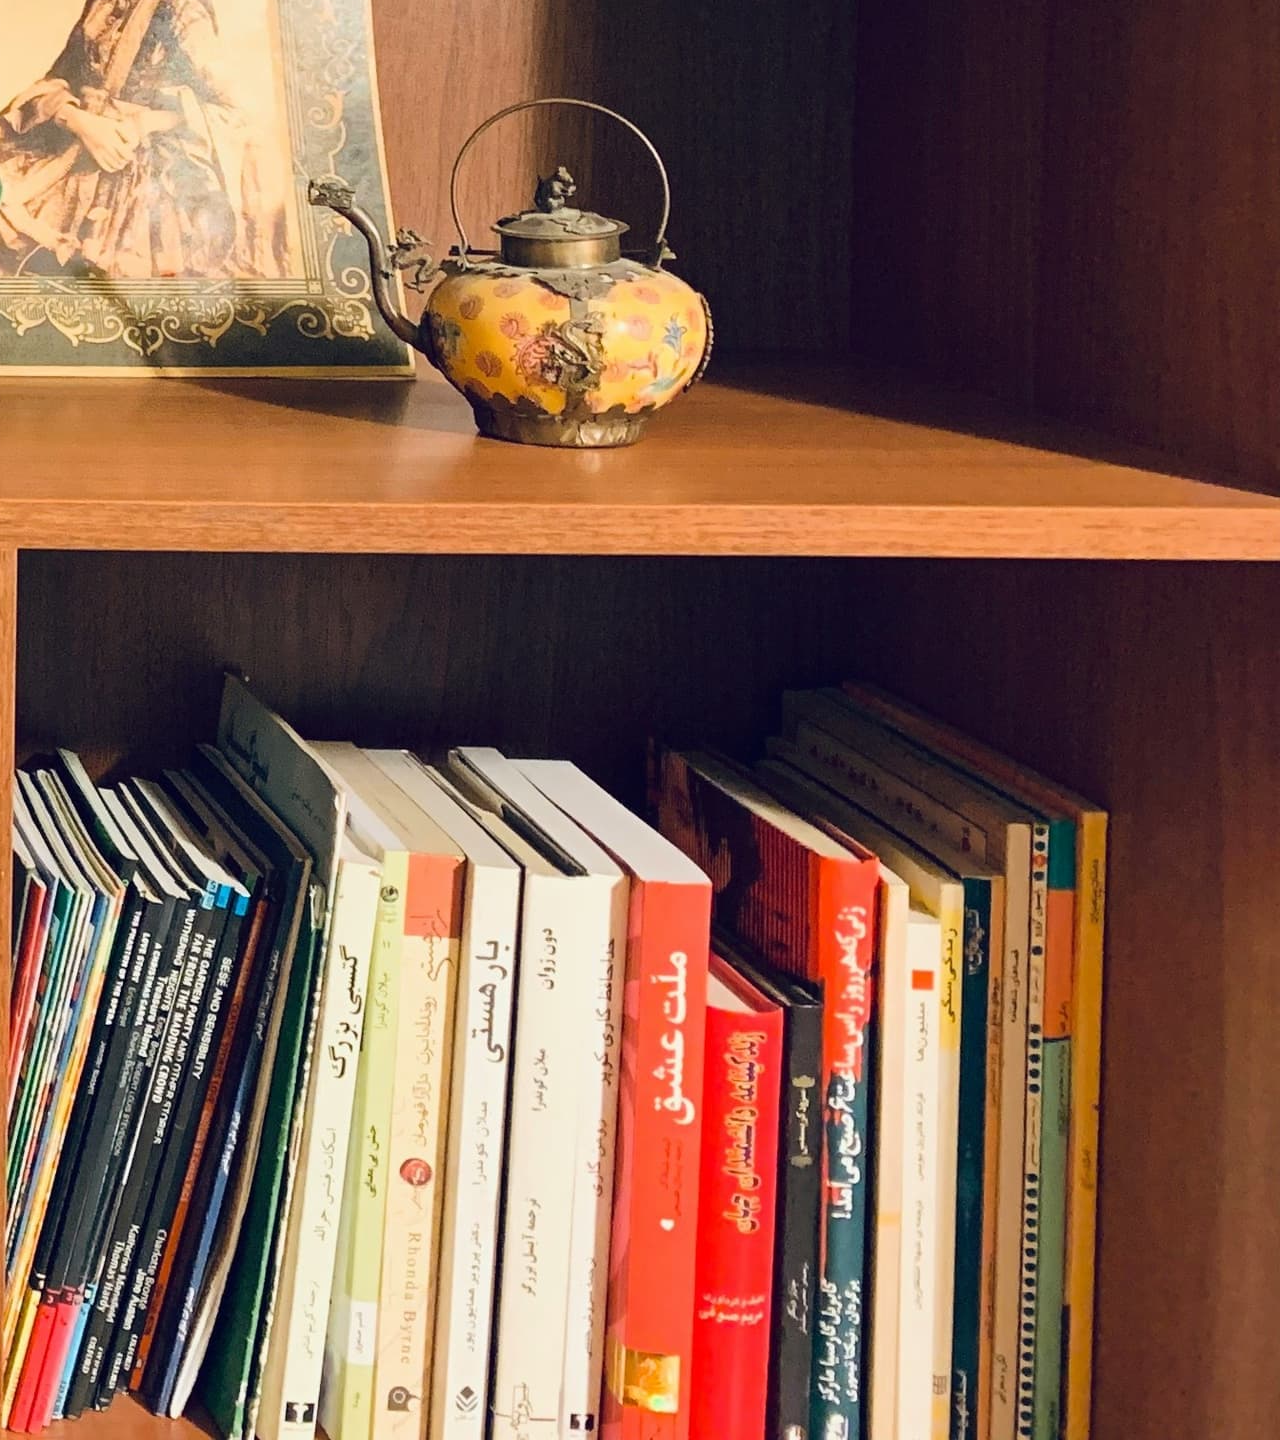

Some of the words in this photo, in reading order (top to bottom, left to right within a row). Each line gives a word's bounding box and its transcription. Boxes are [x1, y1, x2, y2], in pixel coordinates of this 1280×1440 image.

[173, 909, 197, 966] WUTHERING
[192, 932, 205, 954] FAR
[474, 939, 511, 978] بار
[160, 967, 179, 1012] HEIGHTS
[182, 955, 199, 990] FROM
[337, 944, 363, 1016] گتسبی
[147, 975, 169, 1024] Treasure
[176, 990, 192, 1014] THE
[209, 987, 224, 1012] AND
[138, 1024, 154, 1058] Island
[162, 1012, 185, 1063] MADDING
[472, 983, 507, 1064] هستی
[192, 1011, 218, 1080] SENSIBILITY
[327, 1021, 355, 1079] بزرگ
[151, 1063, 170, 1104] CROWD
[651, 1029, 697, 1126] عشق
[104, 1240, 125, 1282] Thomas
[132, 1268, 146, 1295] Jane
[404, 1231, 423, 1302] Rhonda
[96, 1282, 114, 1314] Hardy
[122, 1293, 140, 1331] Austen
